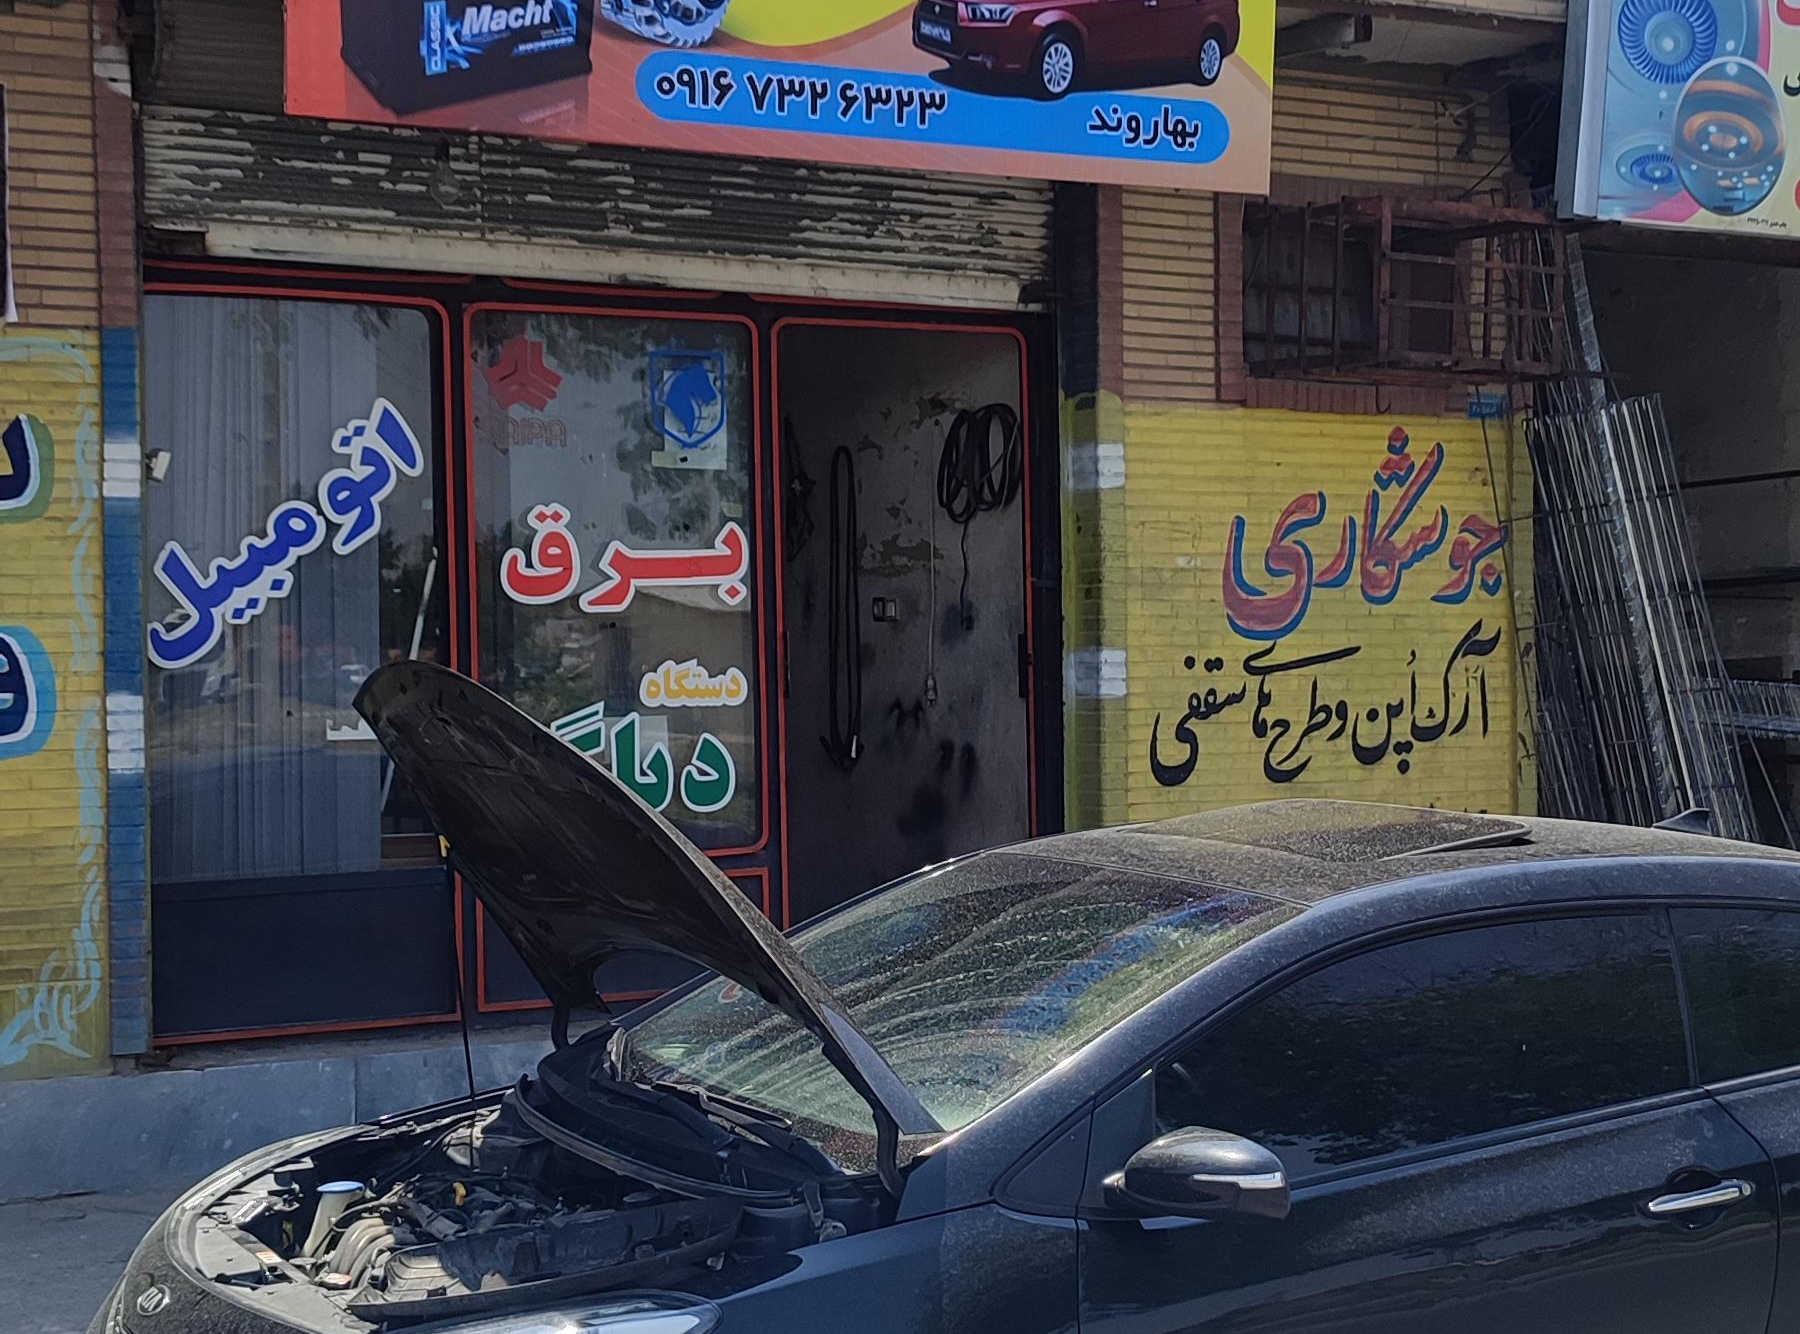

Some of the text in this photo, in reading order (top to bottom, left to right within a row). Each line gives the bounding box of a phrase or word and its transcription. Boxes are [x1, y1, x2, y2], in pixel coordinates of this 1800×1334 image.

[656, 67, 947, 126] ۰۹۱۶ ۷۳۲ ۶۳۲۳
[1088, 106, 1200, 149] بهاروند
[504, 507, 746, 609] برق
[1222, 426, 1509, 641] جوشکاری
[643, 662, 744, 703] دستگاه
[1150, 655, 1247, 787] سقفی
